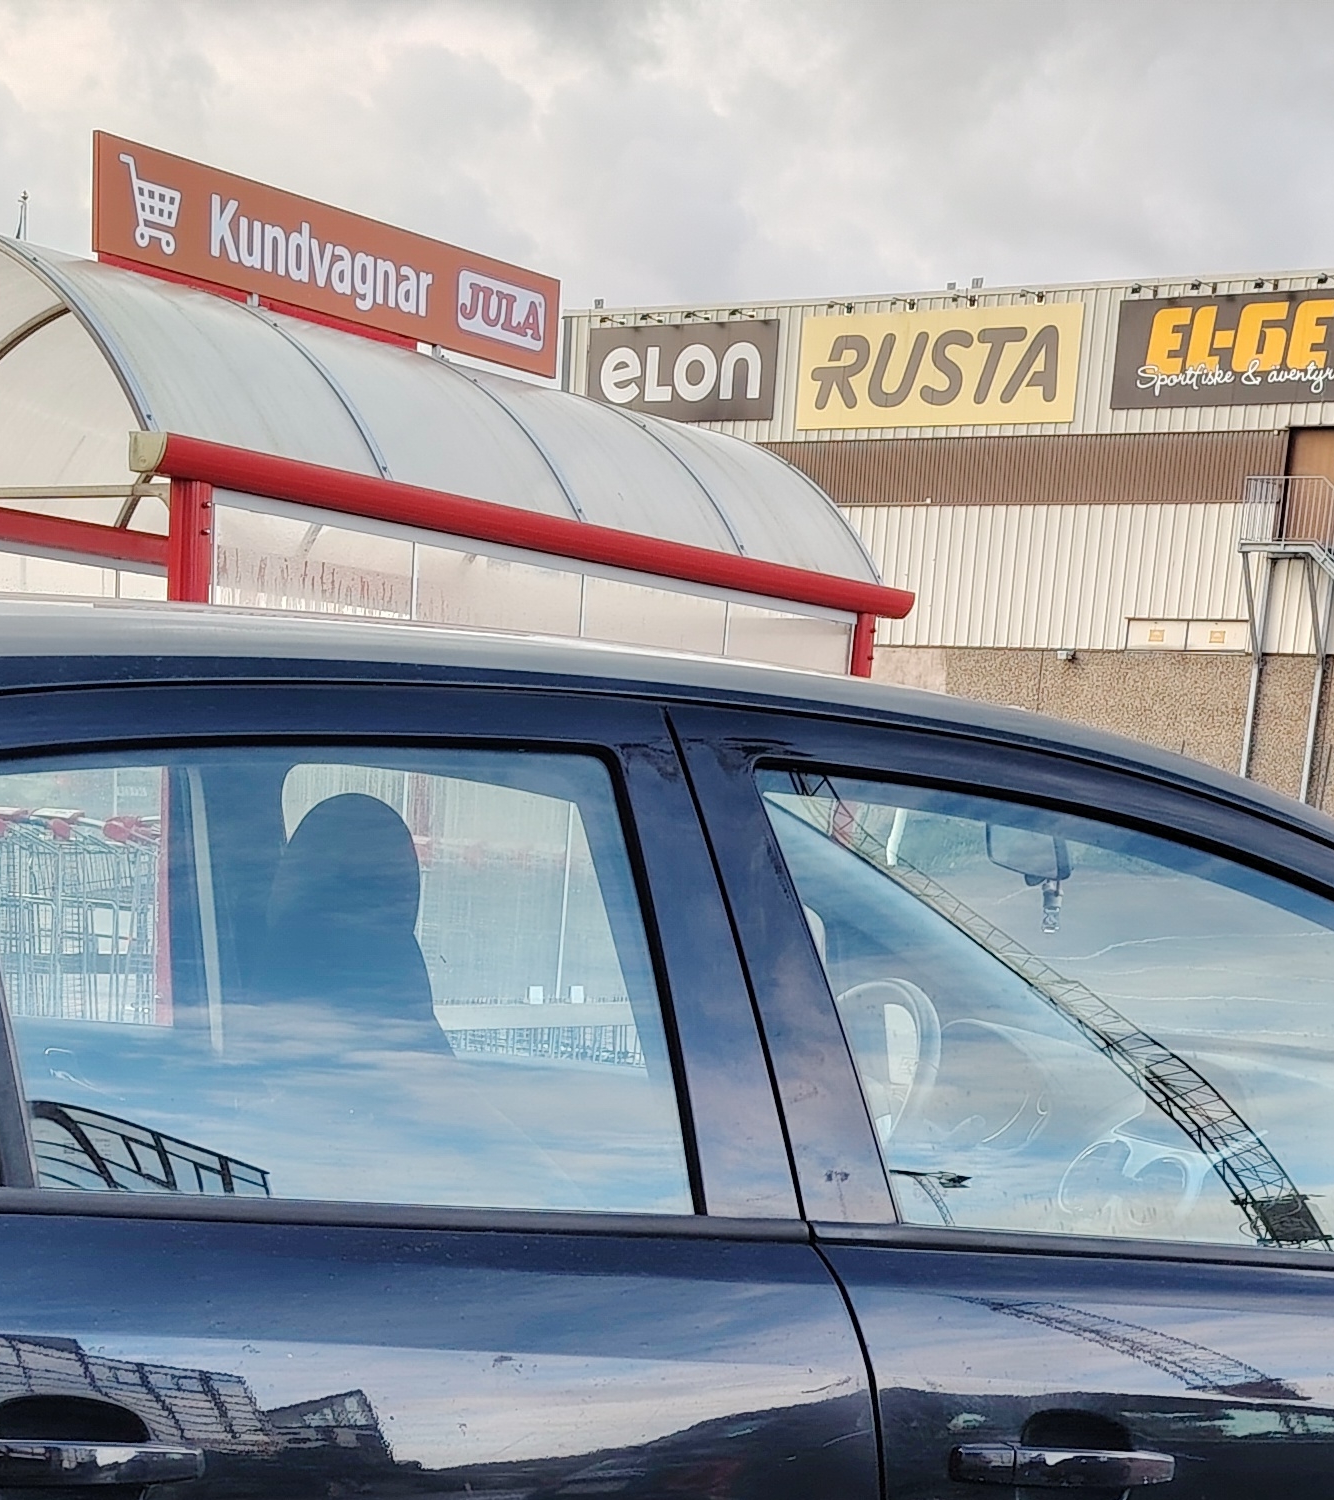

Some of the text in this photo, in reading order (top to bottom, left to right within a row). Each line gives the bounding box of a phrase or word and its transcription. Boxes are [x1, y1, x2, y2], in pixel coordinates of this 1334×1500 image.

[208, 192, 434, 318] Kundvagnar
[460, 282, 542, 341] JULA
[810, 324, 1060, 411] RUSTA
[1136, 364, 1235, 397] Sportfiske
[1241, 358, 1263, 386] &
